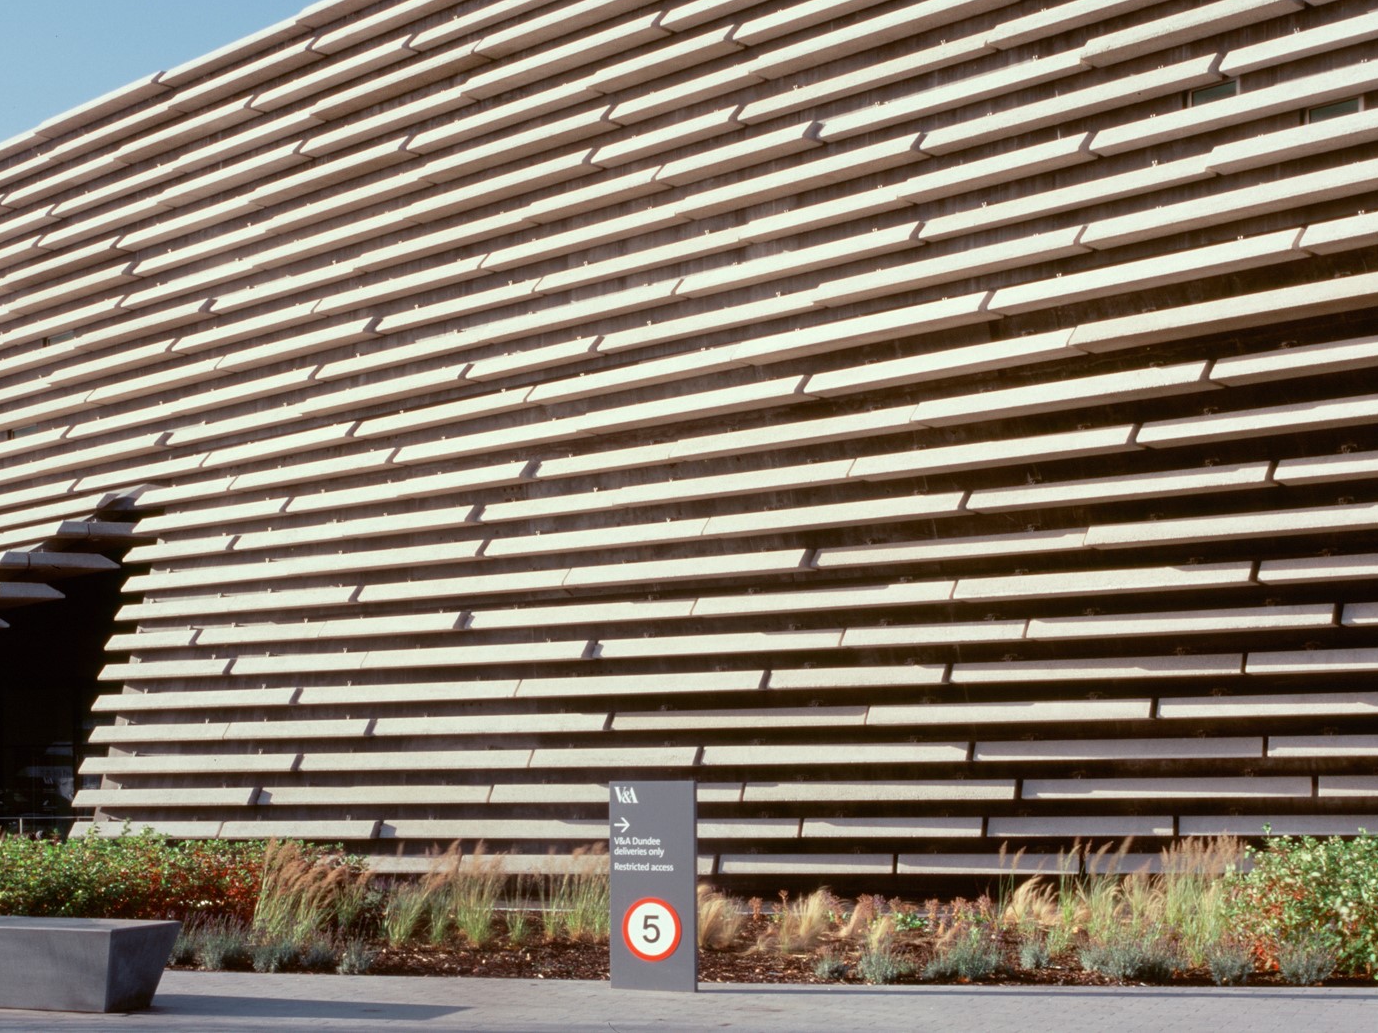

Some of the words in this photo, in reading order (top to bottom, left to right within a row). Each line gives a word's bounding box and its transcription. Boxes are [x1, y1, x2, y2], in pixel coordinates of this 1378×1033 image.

[614, 786, 639, 804] V&A
[614, 837, 631, 845] V&A
[632, 836, 661, 846] Dundee
[614, 847, 647, 855] deliveries
[648, 847, 665, 858] only
[614, 862, 650, 871] Restricted
[650, 864, 674, 872] access
[643, 915, 661, 943] 5
